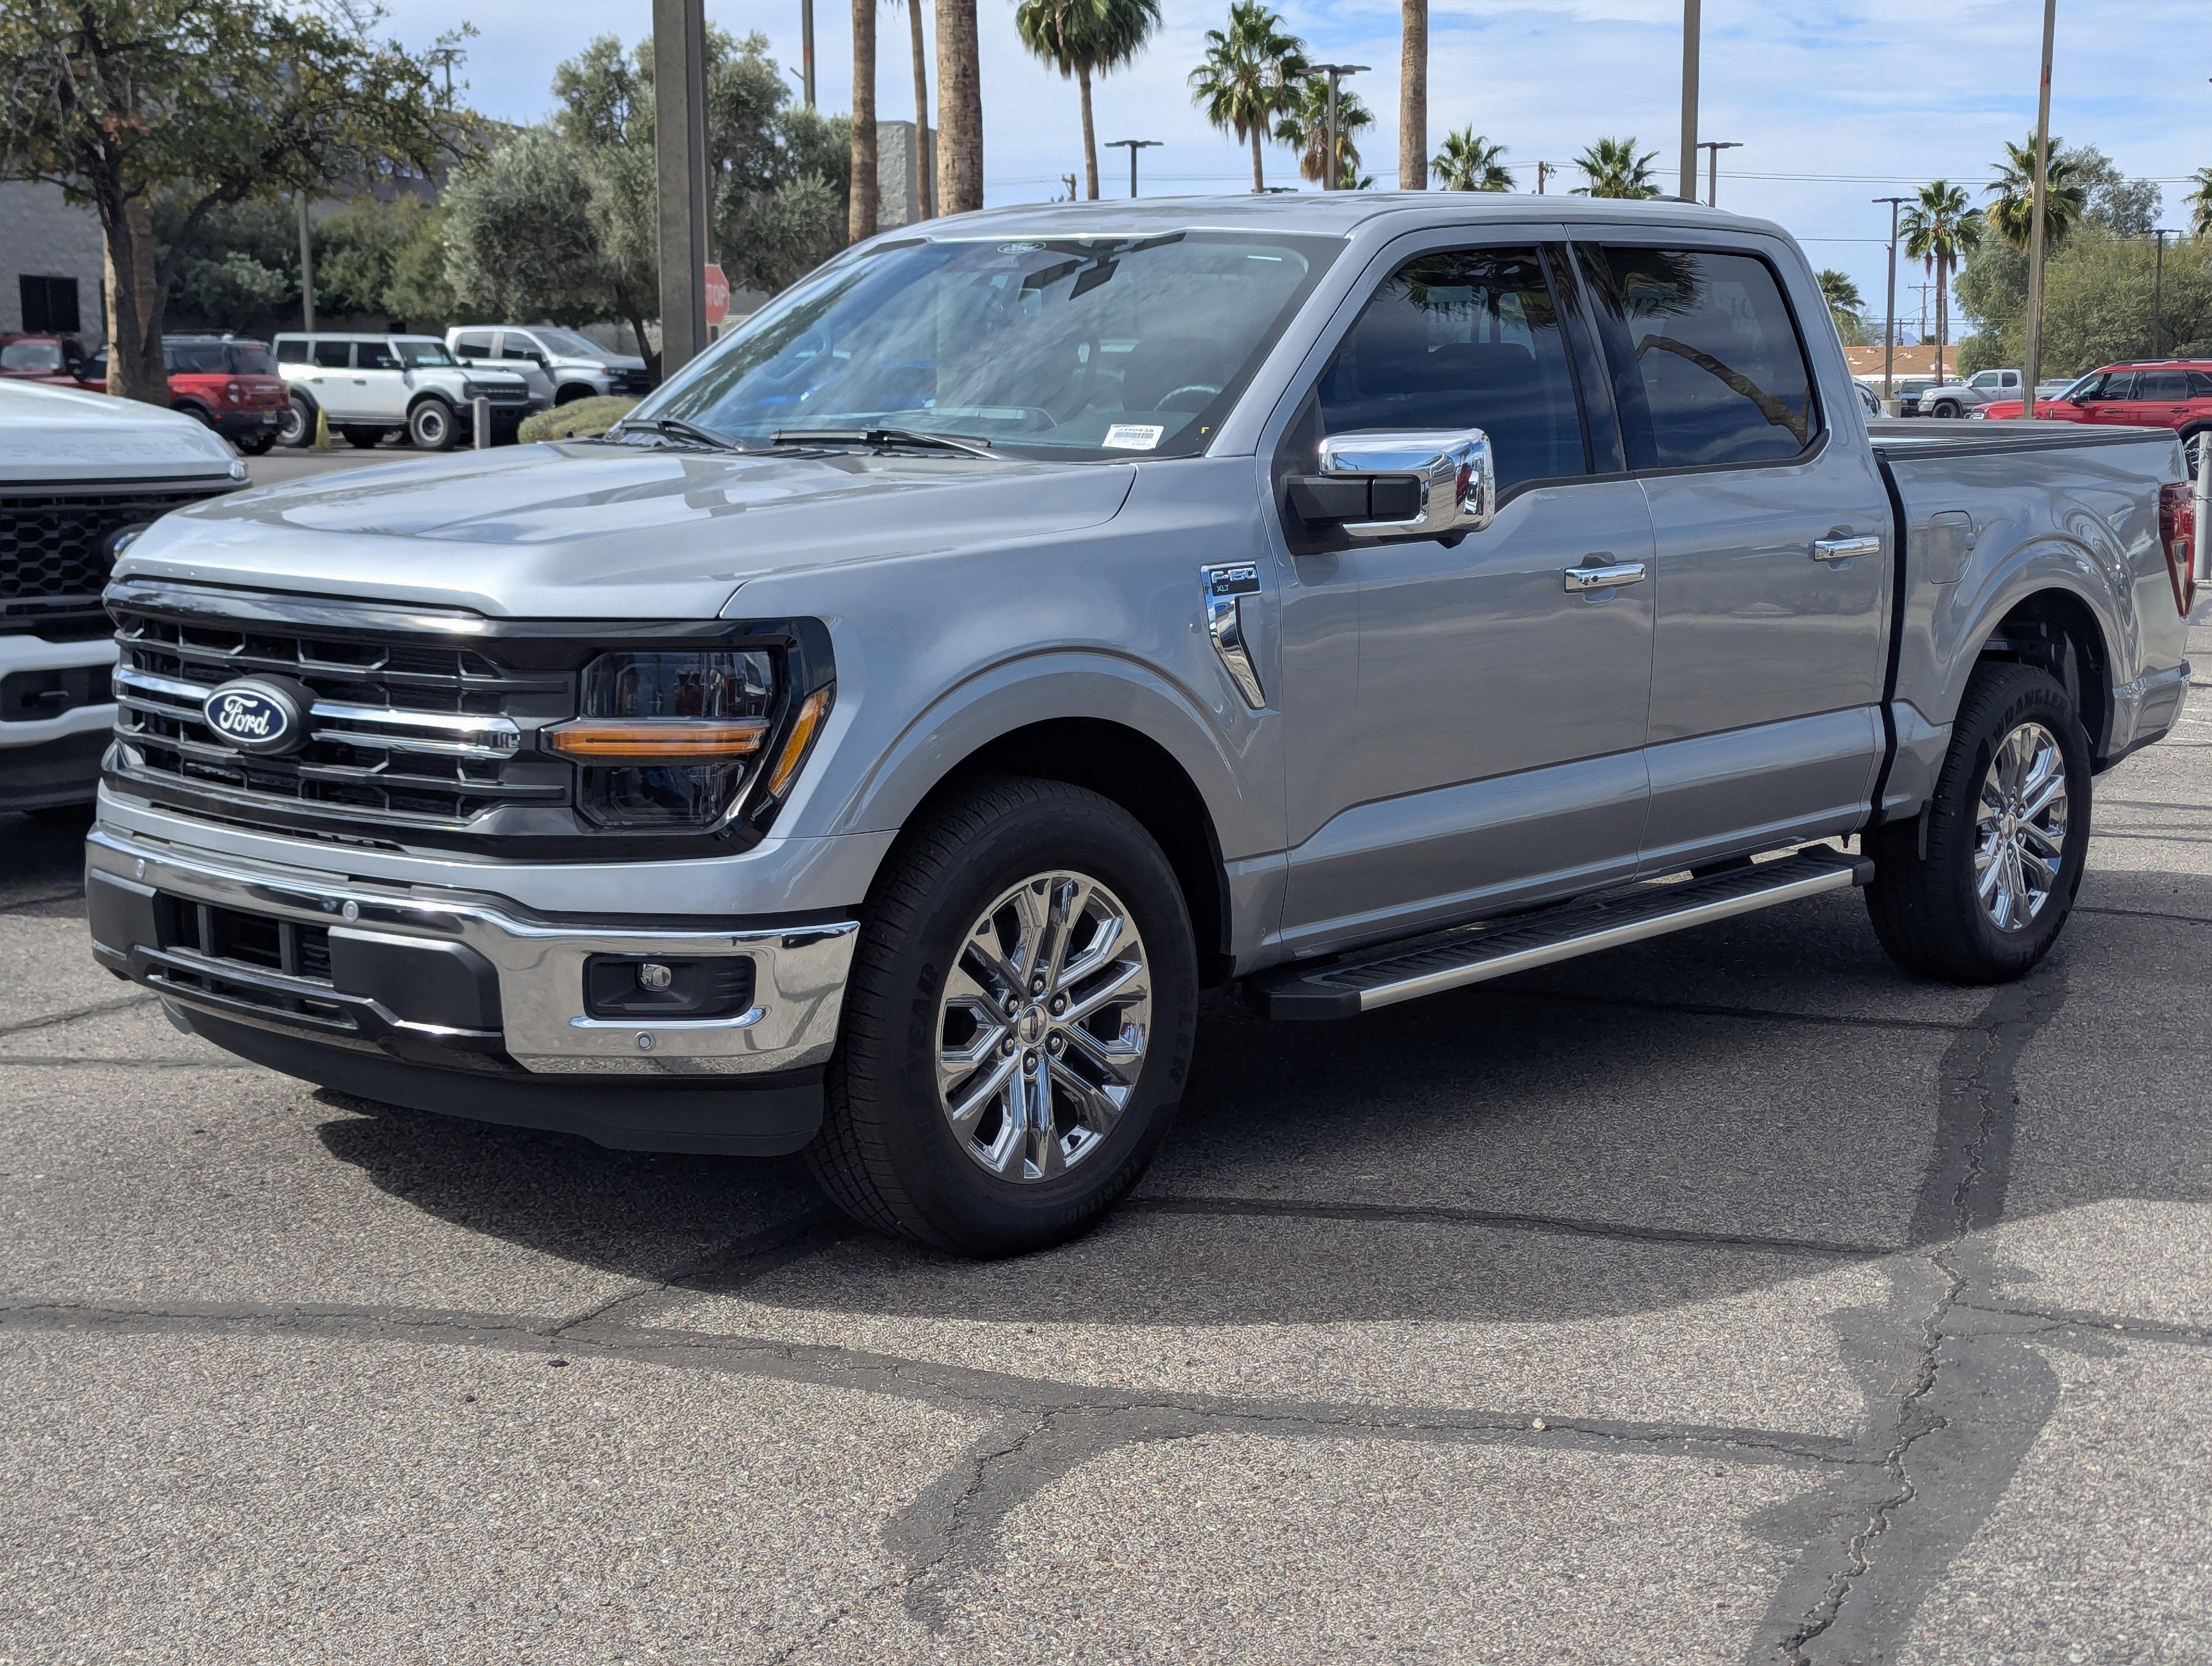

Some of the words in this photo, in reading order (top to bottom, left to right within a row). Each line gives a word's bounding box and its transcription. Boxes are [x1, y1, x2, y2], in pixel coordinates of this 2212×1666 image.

[706, 284, 727, 307] TOP
[1211, 567, 1257, 584] F-150
[219, 695, 271, 735] Ford
